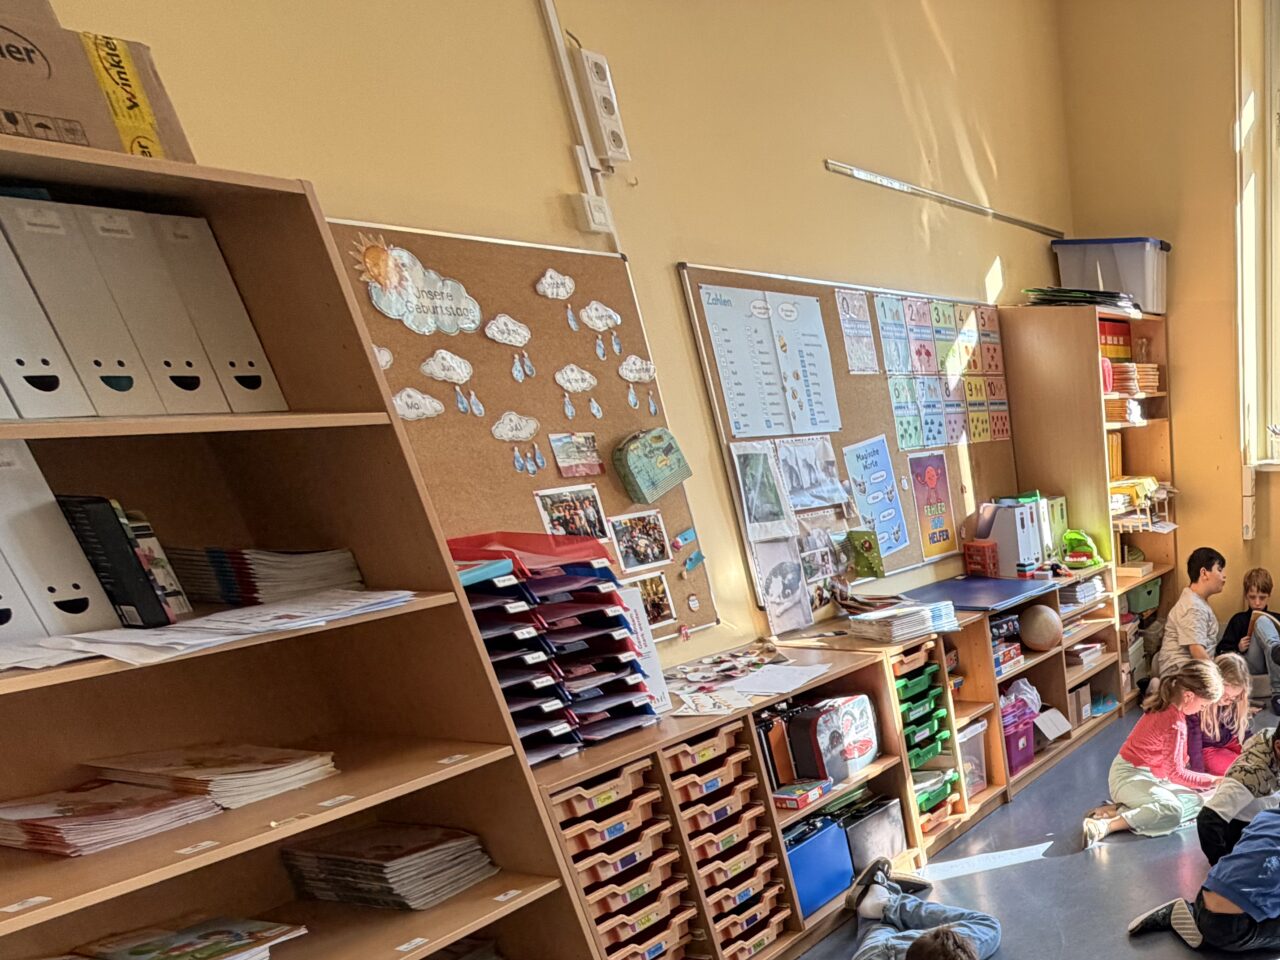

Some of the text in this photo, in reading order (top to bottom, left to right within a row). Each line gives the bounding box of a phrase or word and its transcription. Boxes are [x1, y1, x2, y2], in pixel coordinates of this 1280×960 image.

[413, 285, 454, 301] Unsere
[705, 292, 733, 307] Zahlen
[404, 300, 476, 320] Geburtstage
[924, 502, 946, 516] FEHLER
[928, 529, 950, 545] HELFER
